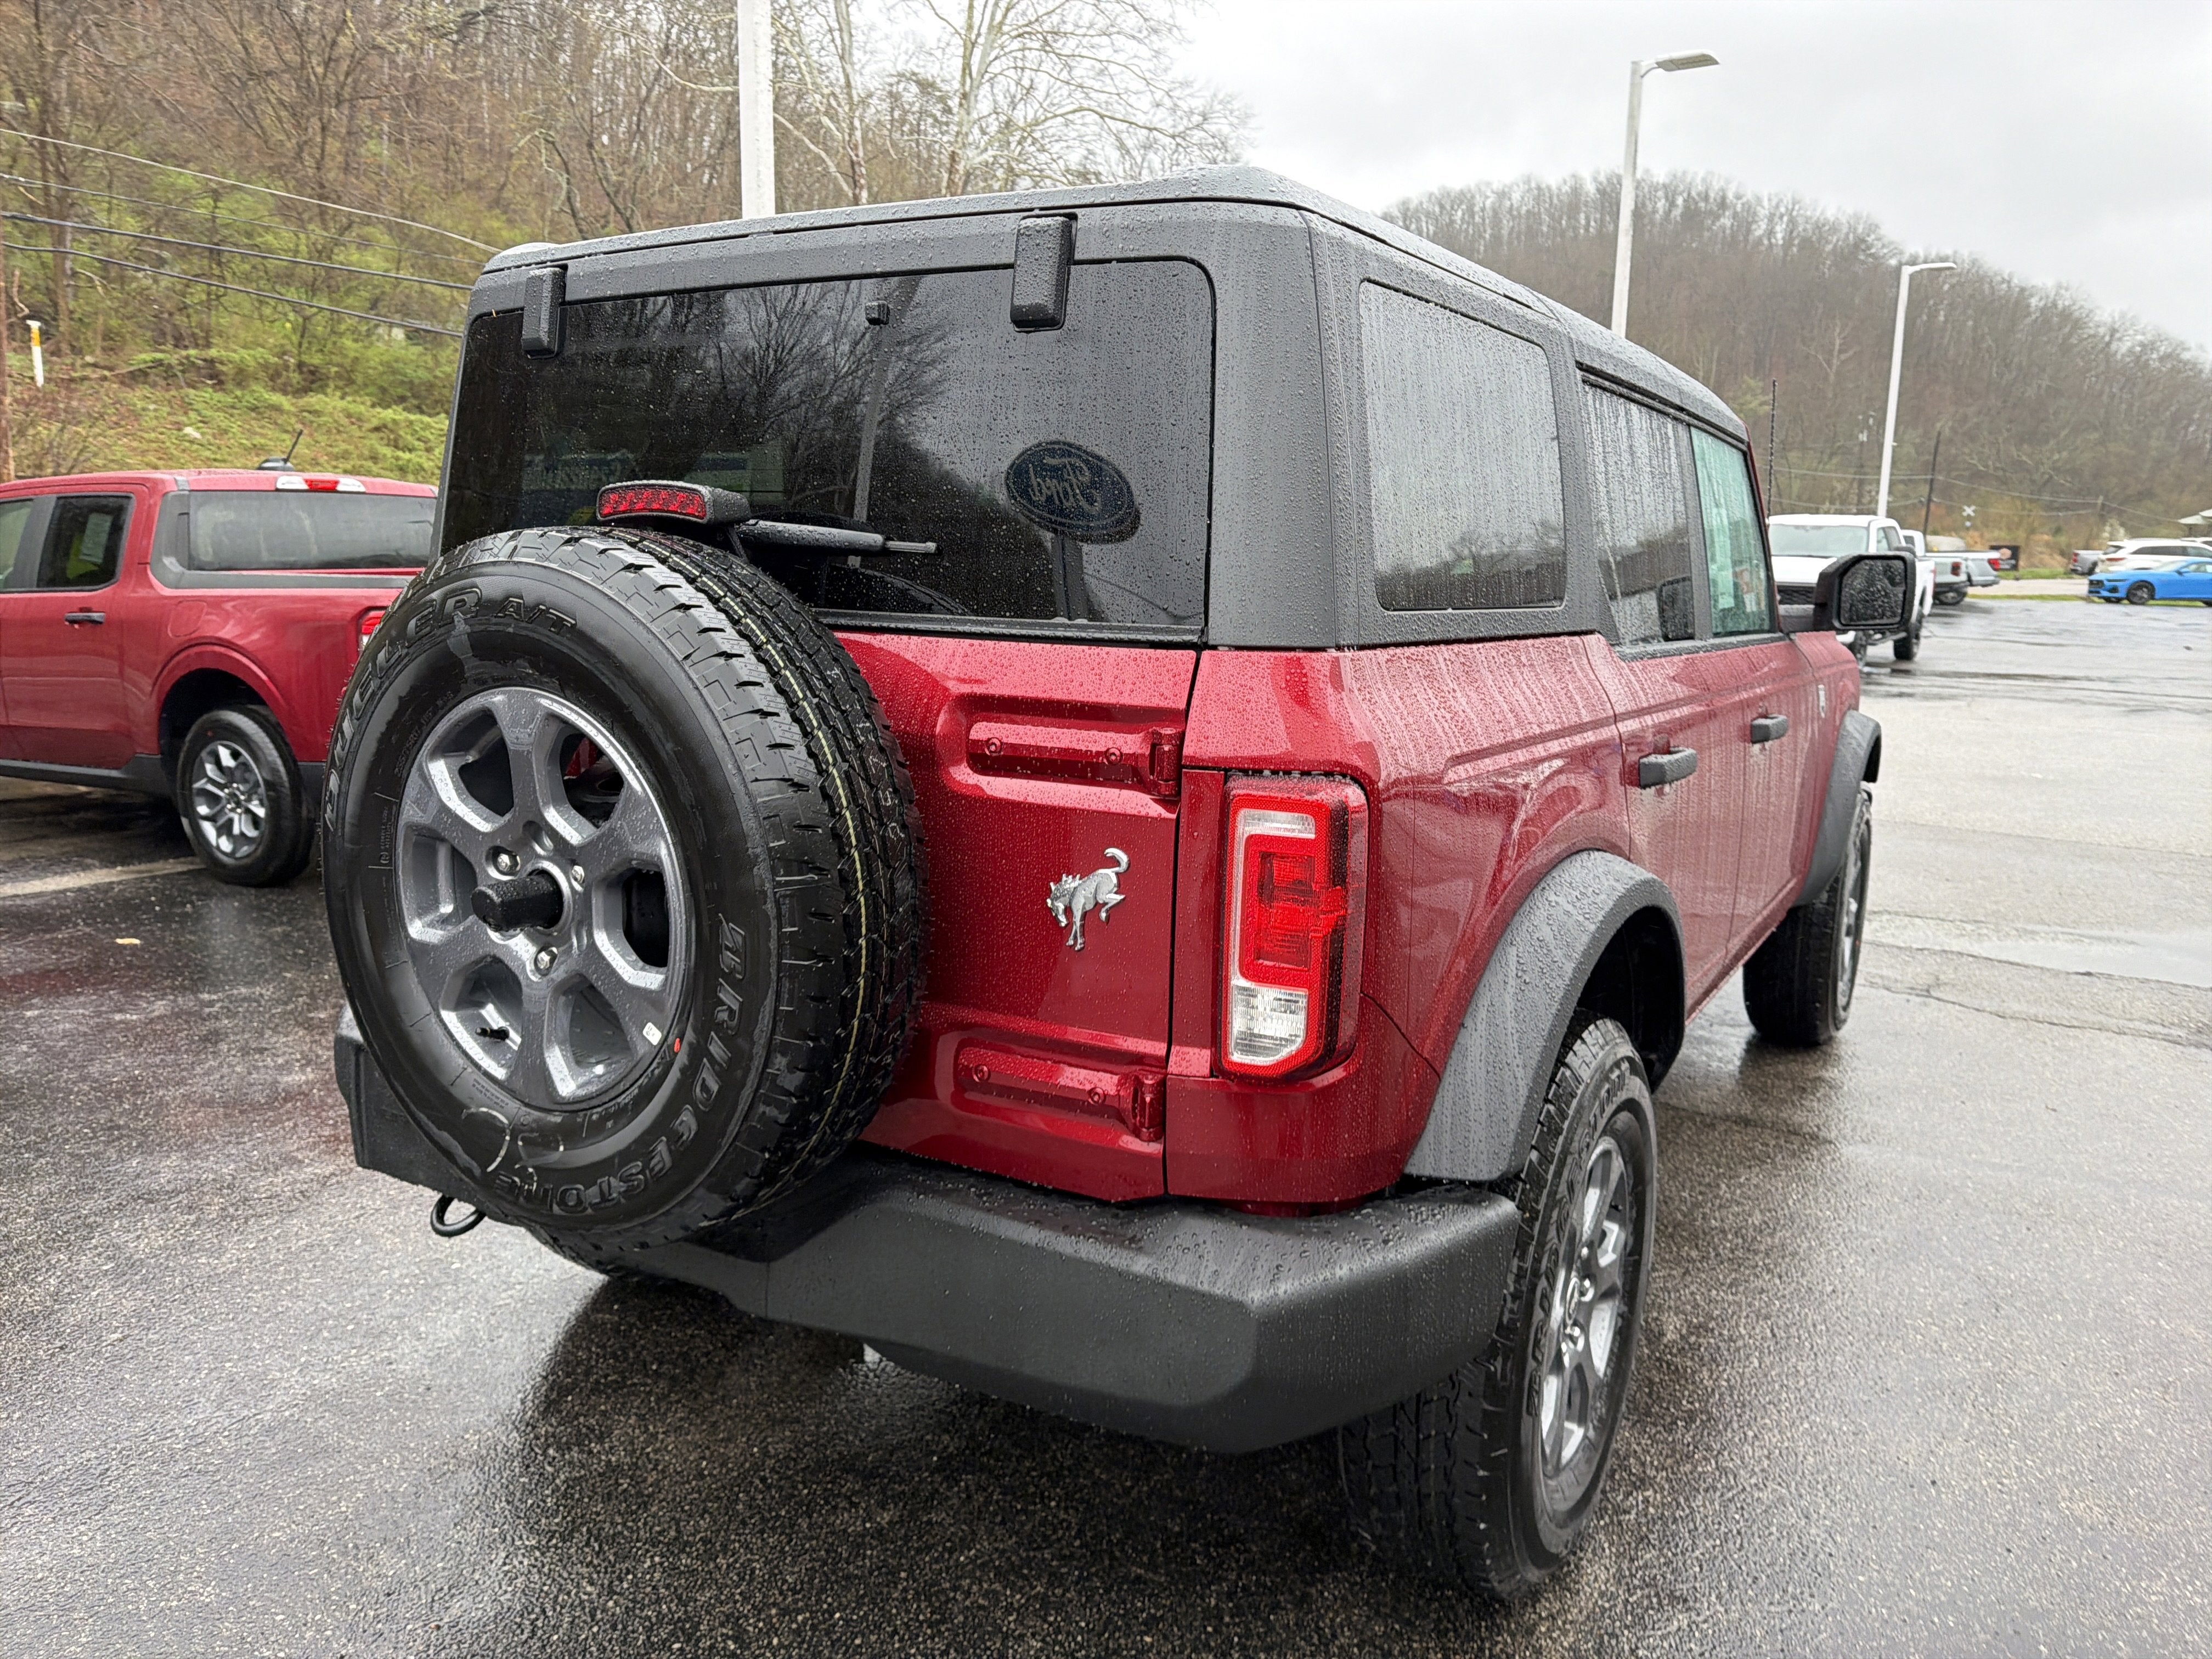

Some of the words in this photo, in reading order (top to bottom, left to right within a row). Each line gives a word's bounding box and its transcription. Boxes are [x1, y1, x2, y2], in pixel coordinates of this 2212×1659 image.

[325, 588, 481, 832] DUELER
[494, 597, 576, 635] A/T
[495, 913, 746, 1215] BRIDGESTONE
